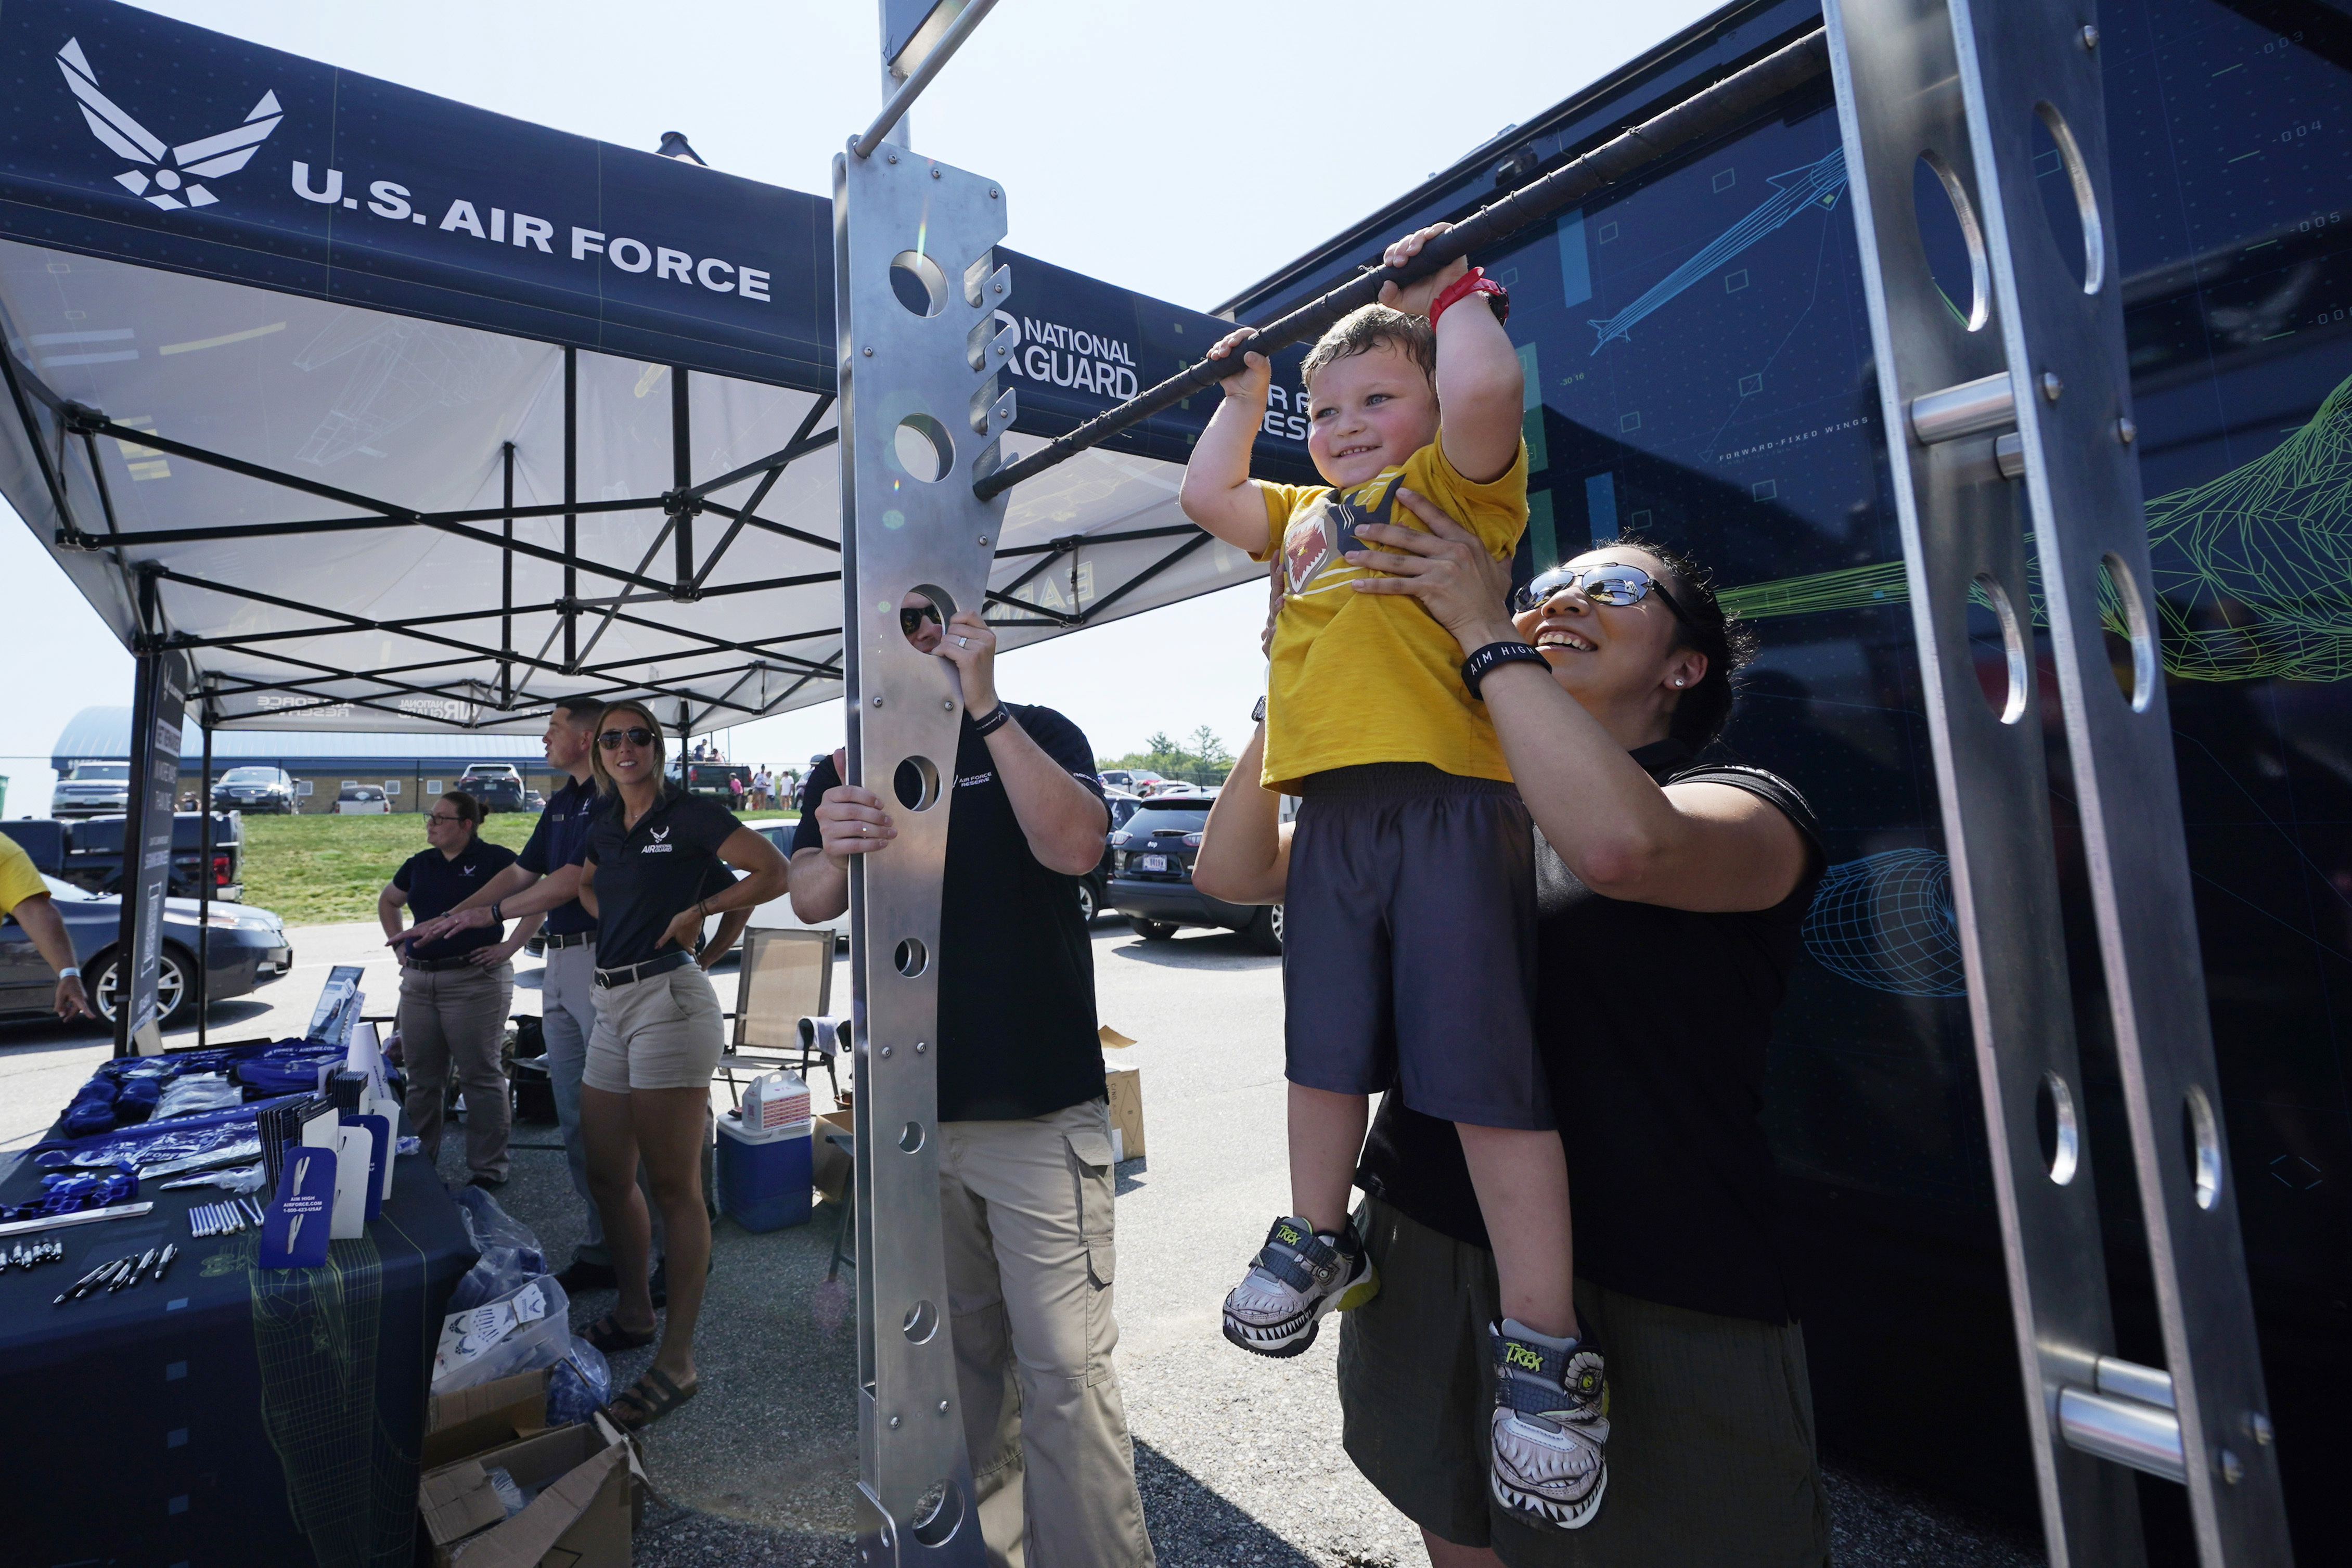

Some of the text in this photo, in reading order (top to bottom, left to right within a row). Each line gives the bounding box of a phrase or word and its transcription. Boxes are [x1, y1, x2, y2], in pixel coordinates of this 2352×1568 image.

[292, 160, 771, 303] U.S. AIR FORCE
[1024, 316, 1136, 367] NATIONAL
[1024, 345, 1138, 401] GUARD
[1719, 417, 1869, 461] FORWARD-FIXED WINGS
[1470, 646, 1535, 675] AIM HIGH
[961, 777, 989, 787] RESERVE
[971, 772, 992, 780] FORCE
[641, 845, 656, 853] AIR
